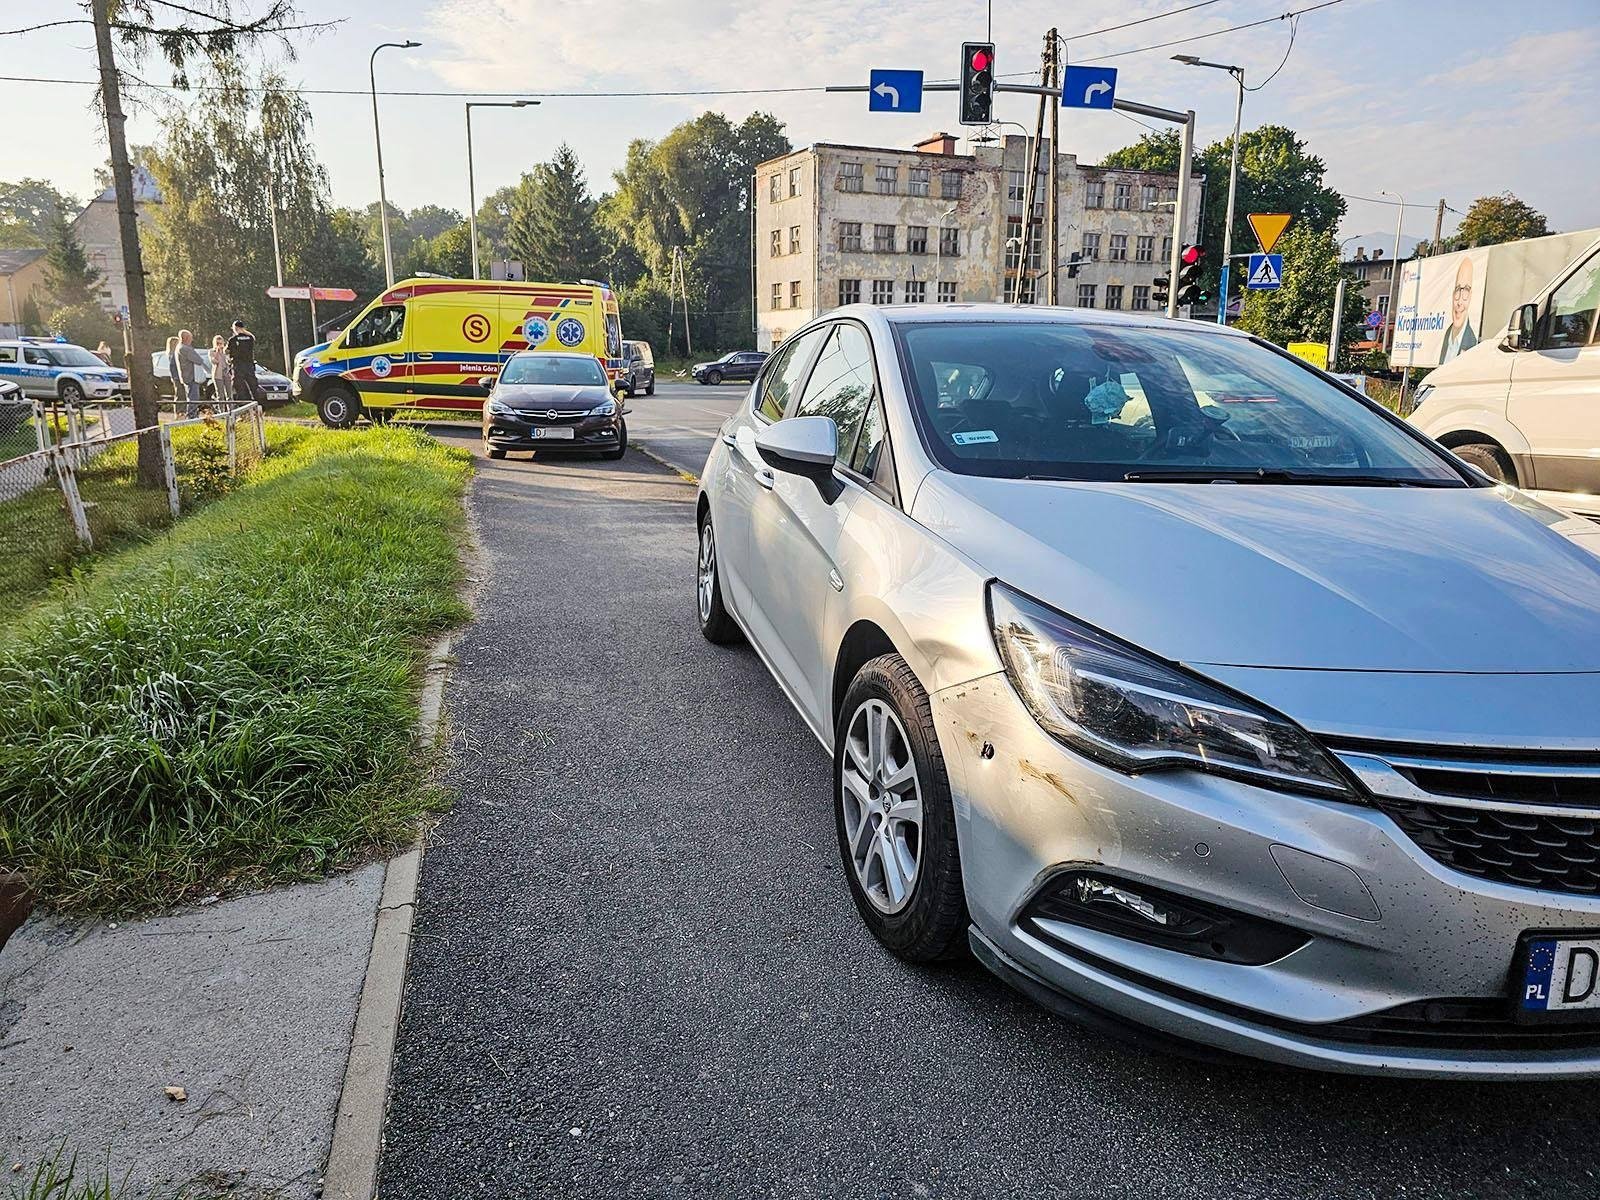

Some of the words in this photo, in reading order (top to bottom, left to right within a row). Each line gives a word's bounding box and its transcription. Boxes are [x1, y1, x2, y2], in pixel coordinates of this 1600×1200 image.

[469, 320, 484, 337] S
[1397, 312, 1445, 335] Kropiwnicki
[460, 364, 482, 372] Jelenia
[482, 364, 498, 372] Góra
[535, 428, 547, 438] DJ
[1562, 946, 1599, 1004] D
[1525, 984, 1546, 1000] PL
